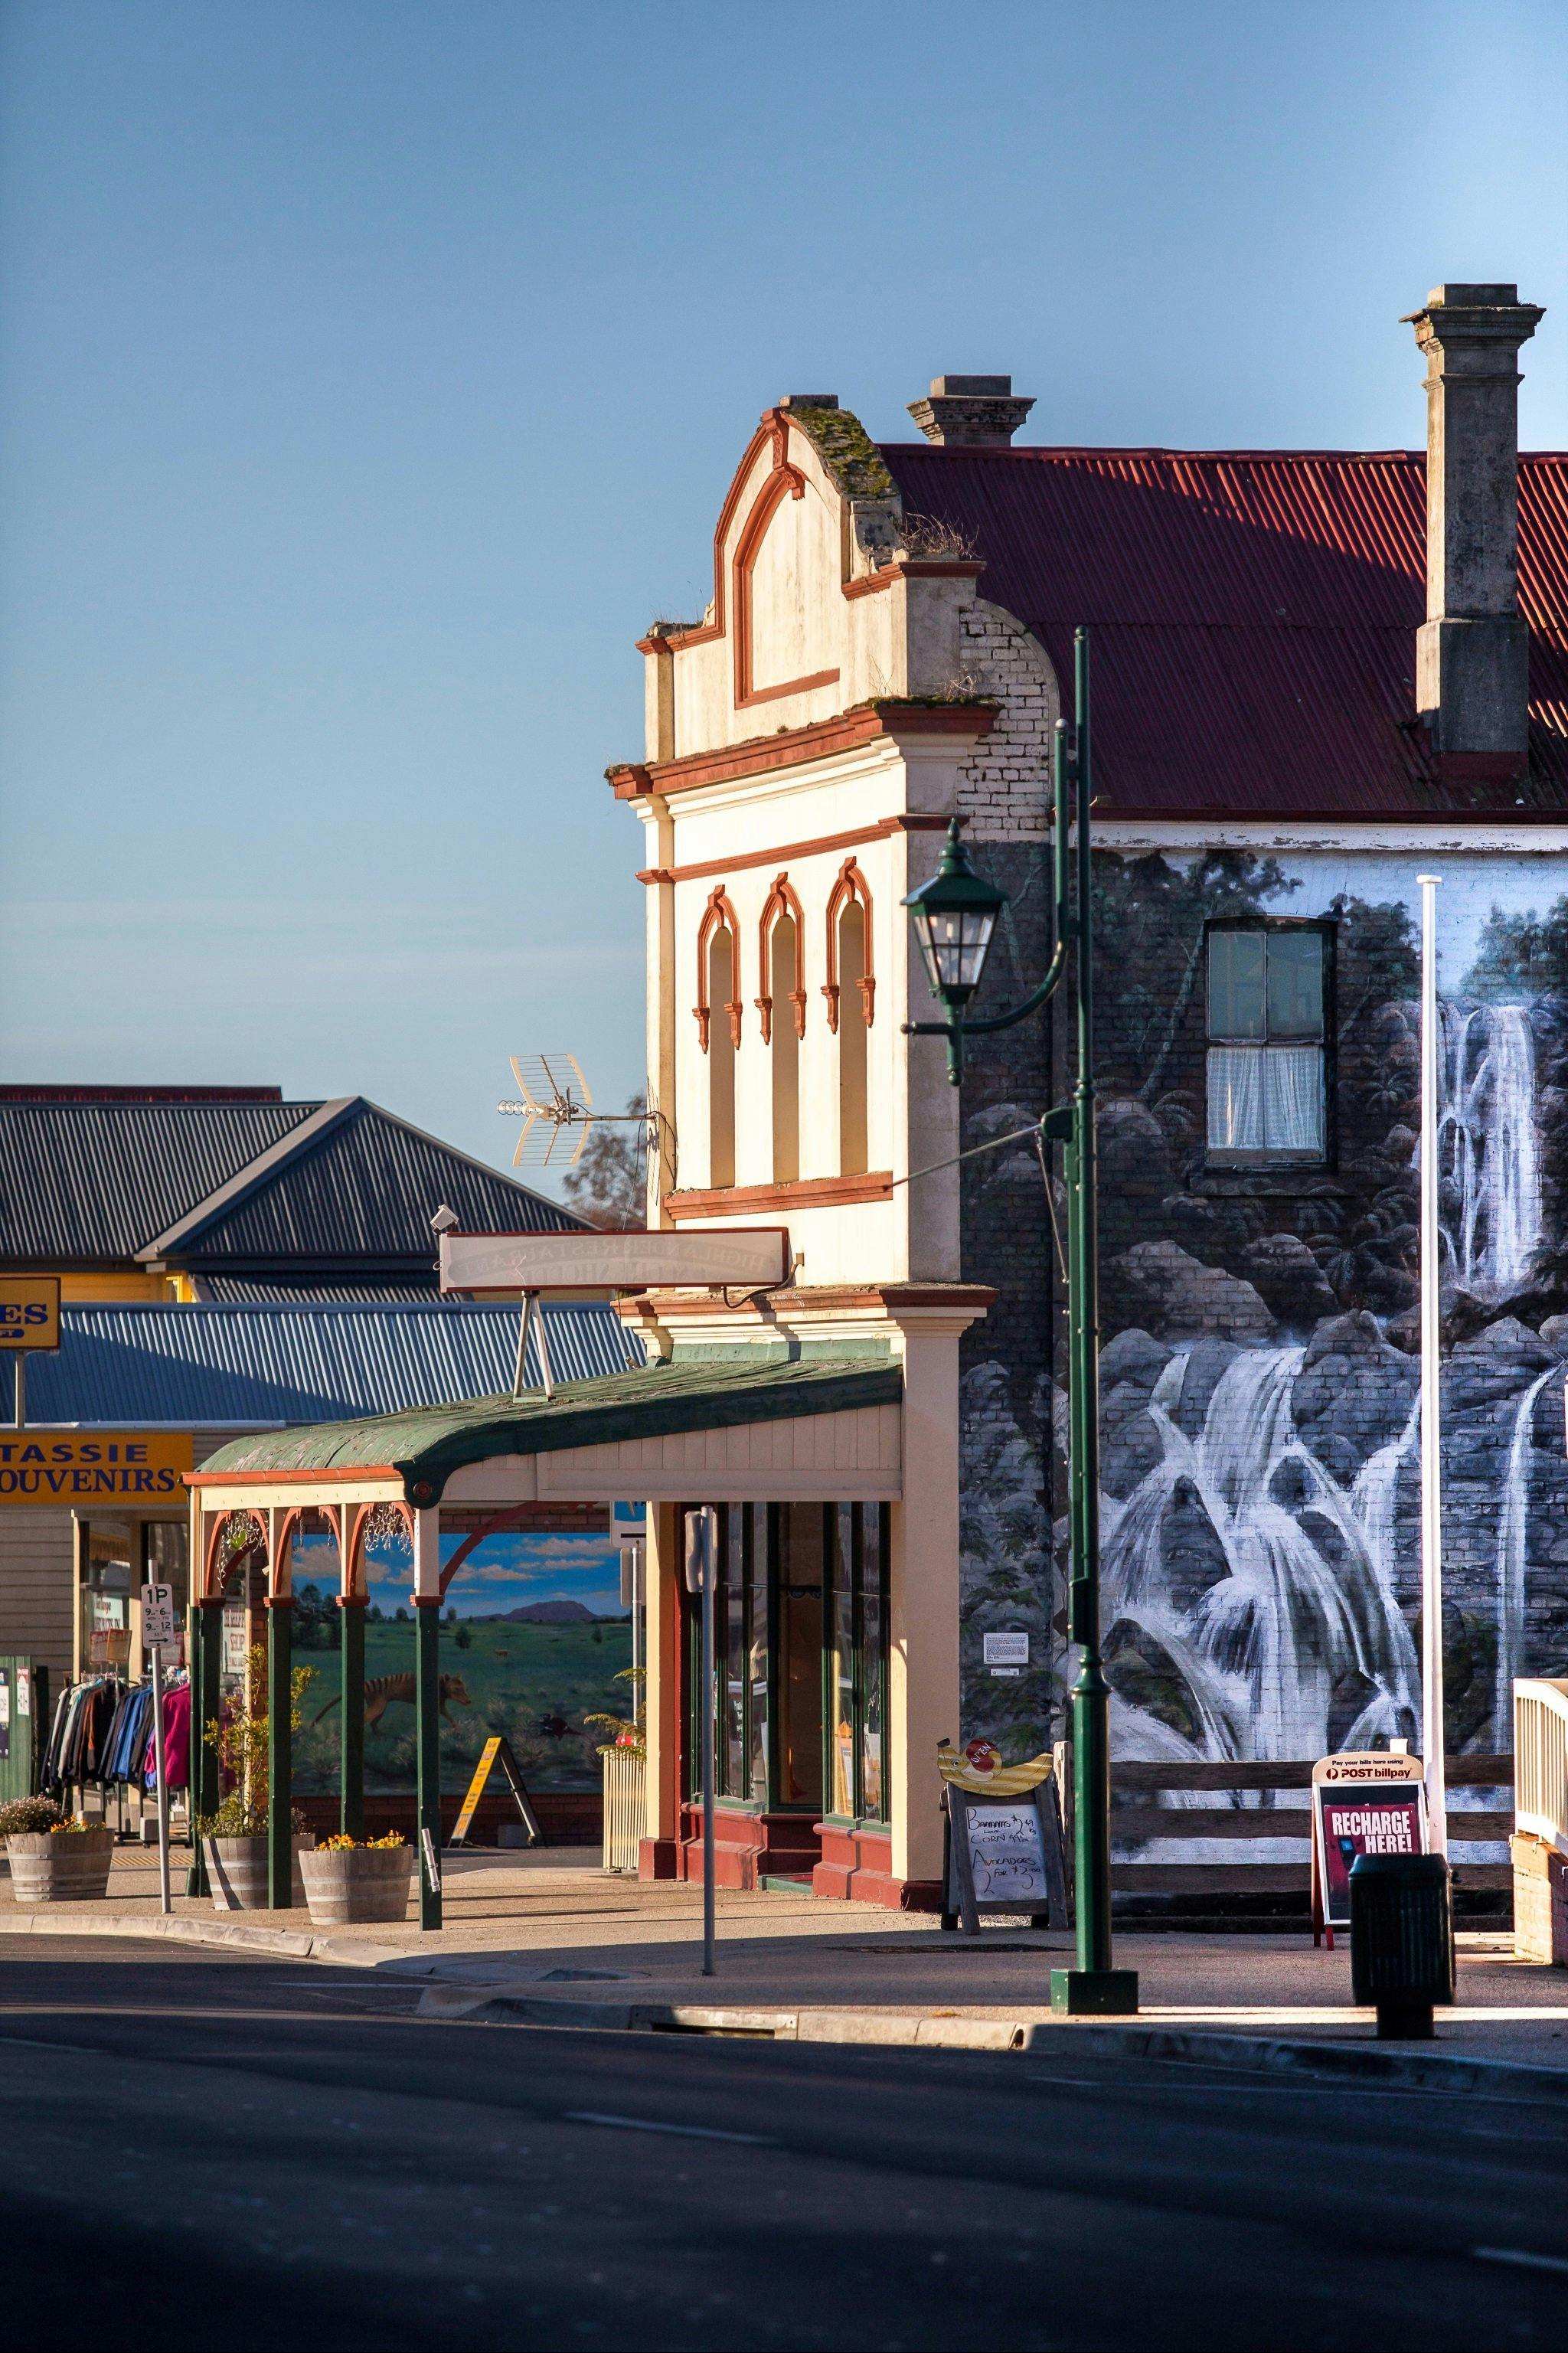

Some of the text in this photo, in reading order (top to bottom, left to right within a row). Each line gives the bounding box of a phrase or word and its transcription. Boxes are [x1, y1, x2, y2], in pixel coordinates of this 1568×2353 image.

[0, 1444, 148, 1462] TASSIE
[147, 1588, 168, 1604] 1P
[971, 1742, 991, 1763] OPEN
[1341, 1767, 1411, 1779] POST billpay
[1332, 1811, 1411, 1836] RECHARGE
[970, 1834, 1005, 1844] CORN
[1364, 1834, 1413, 1854] HERE!
[977, 1870, 995, 1894] 2
